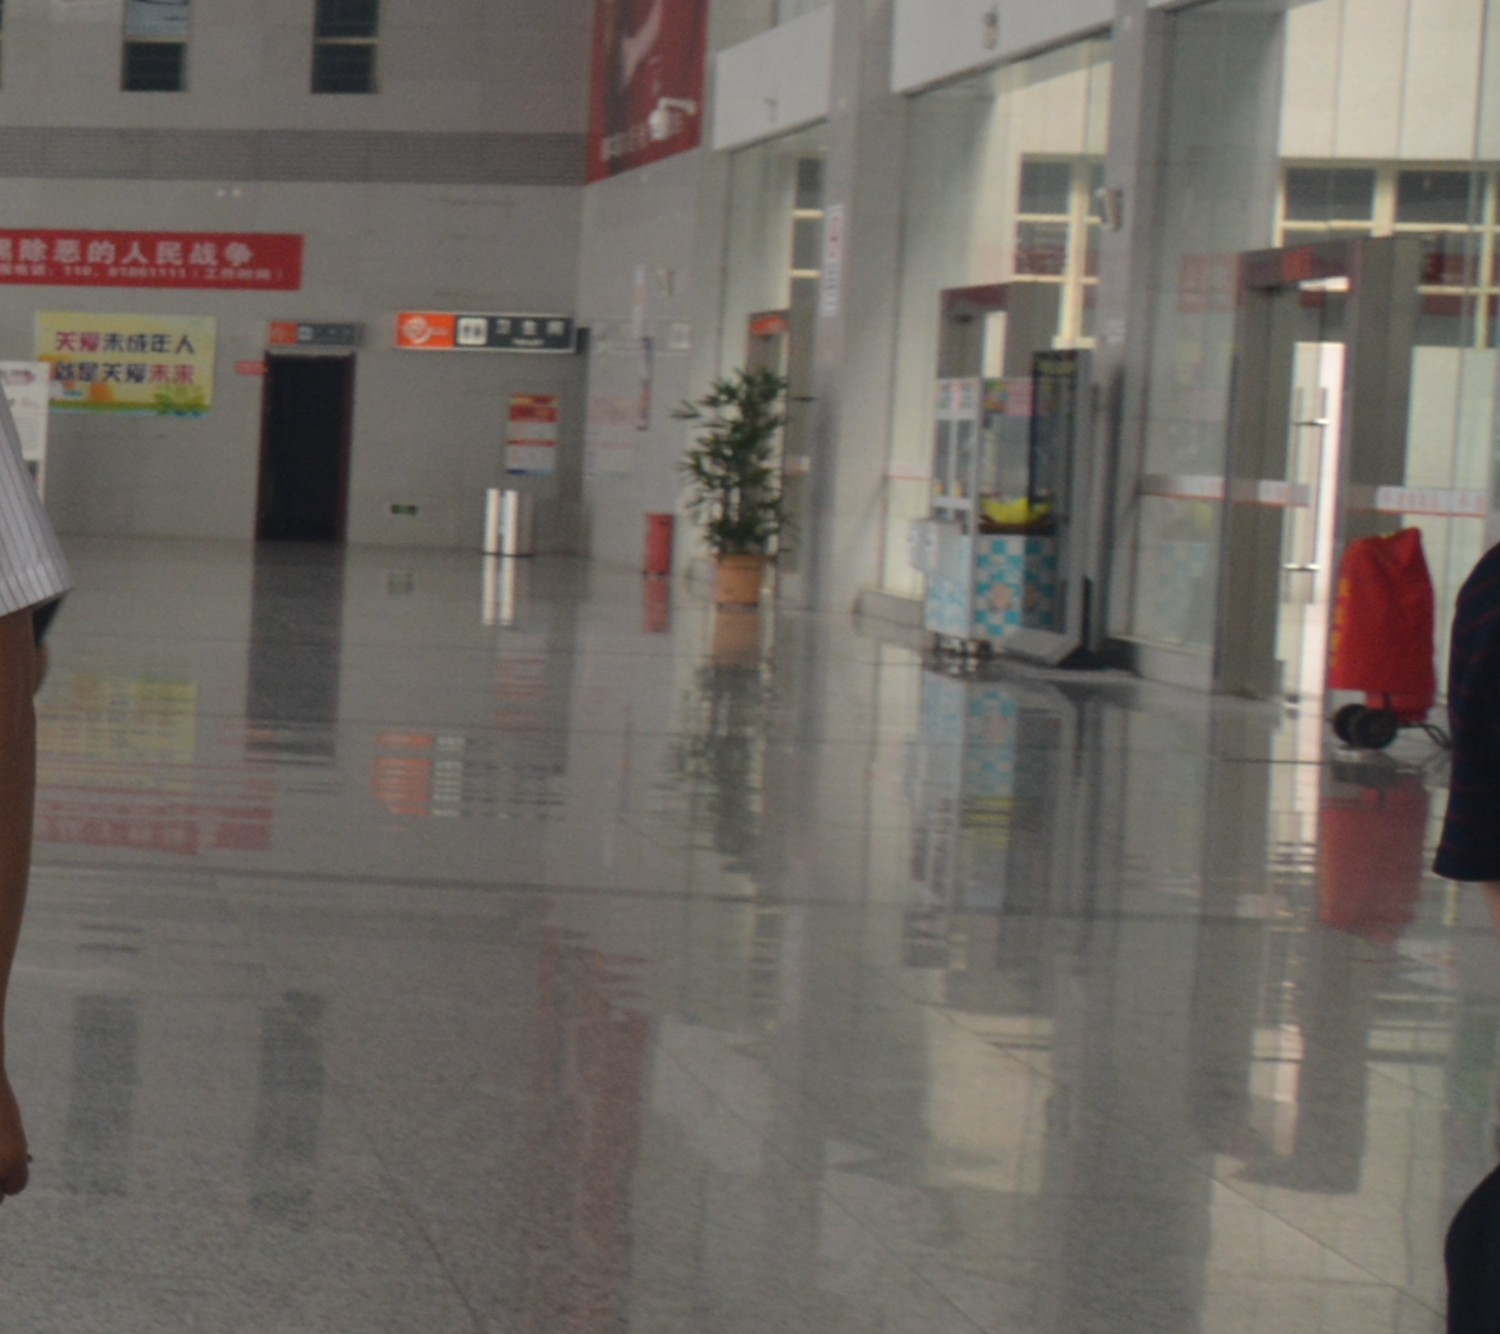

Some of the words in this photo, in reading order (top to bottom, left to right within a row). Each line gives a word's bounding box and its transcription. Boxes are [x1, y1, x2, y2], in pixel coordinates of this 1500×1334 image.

[55, 330, 196, 355] 关爱未成年人
[54, 361, 195, 385] 就是关爱未来
